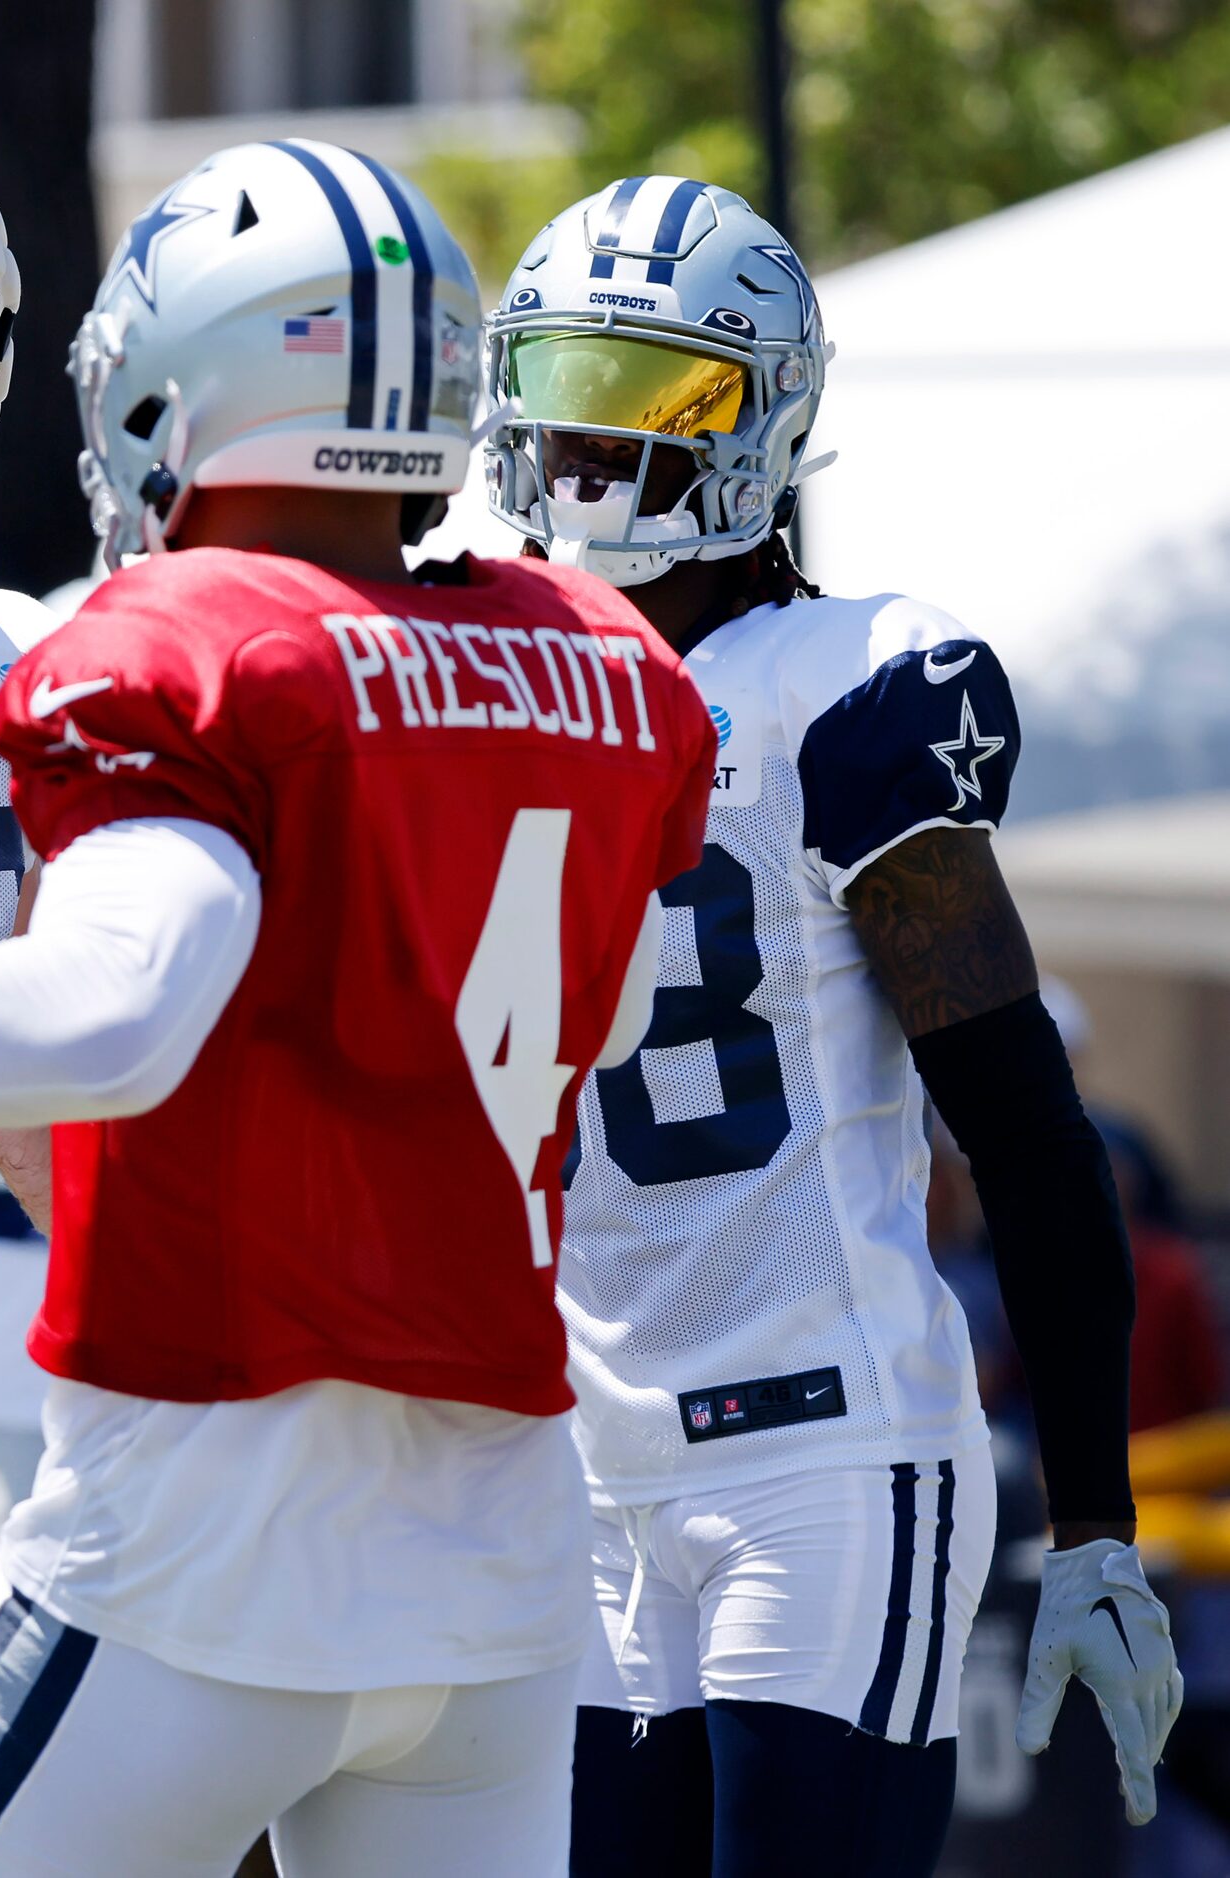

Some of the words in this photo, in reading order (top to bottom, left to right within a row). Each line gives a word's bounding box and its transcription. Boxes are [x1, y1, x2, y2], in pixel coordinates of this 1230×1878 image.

[589, 292, 657, 311] COWBOYS
[314, 447, 444, 477] COWBOYS
[321, 613, 657, 752] PRESCOTT
[454, 808, 578, 1268] 4
[560, 842, 793, 1188] 8
